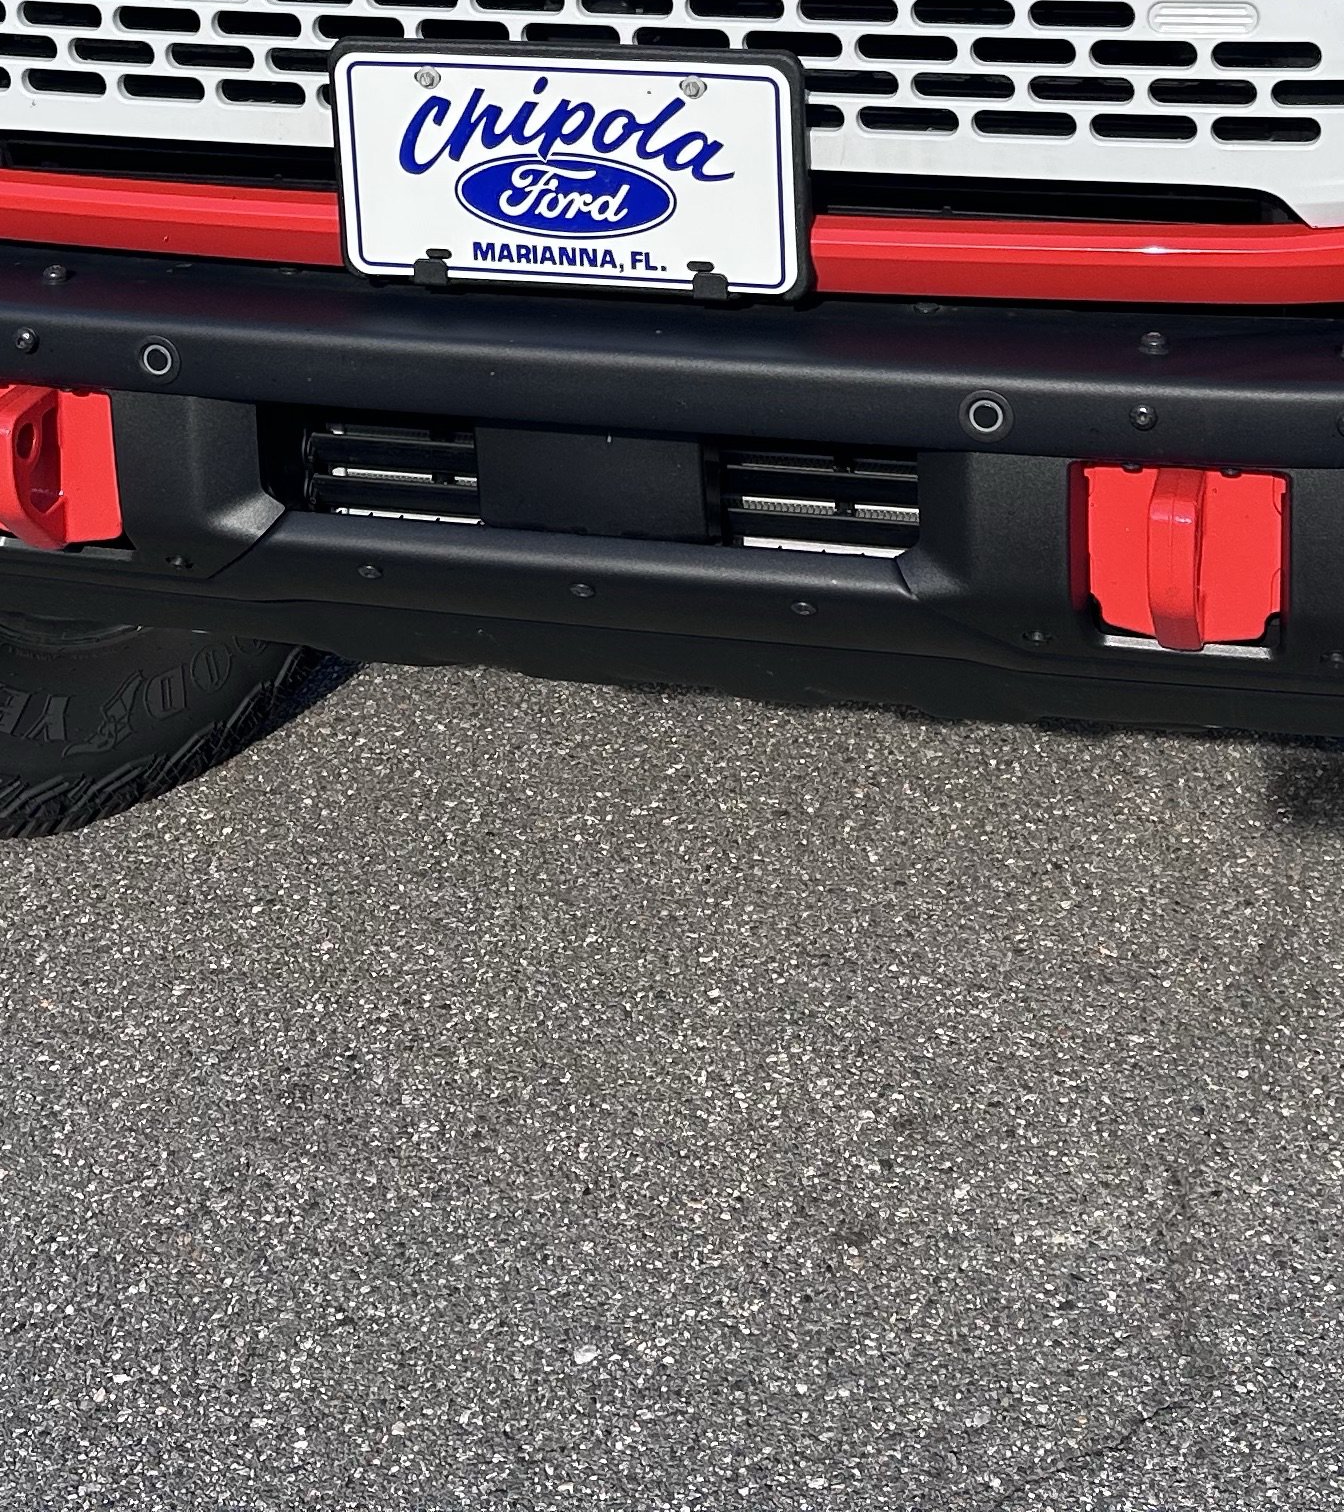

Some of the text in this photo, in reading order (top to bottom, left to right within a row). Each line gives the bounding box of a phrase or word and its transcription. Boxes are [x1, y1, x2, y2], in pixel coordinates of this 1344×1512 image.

[399, 76, 735, 182] Chipola
[499, 160, 631, 224] Ford
[472, 241, 668, 273] MARIANNA, FL.
